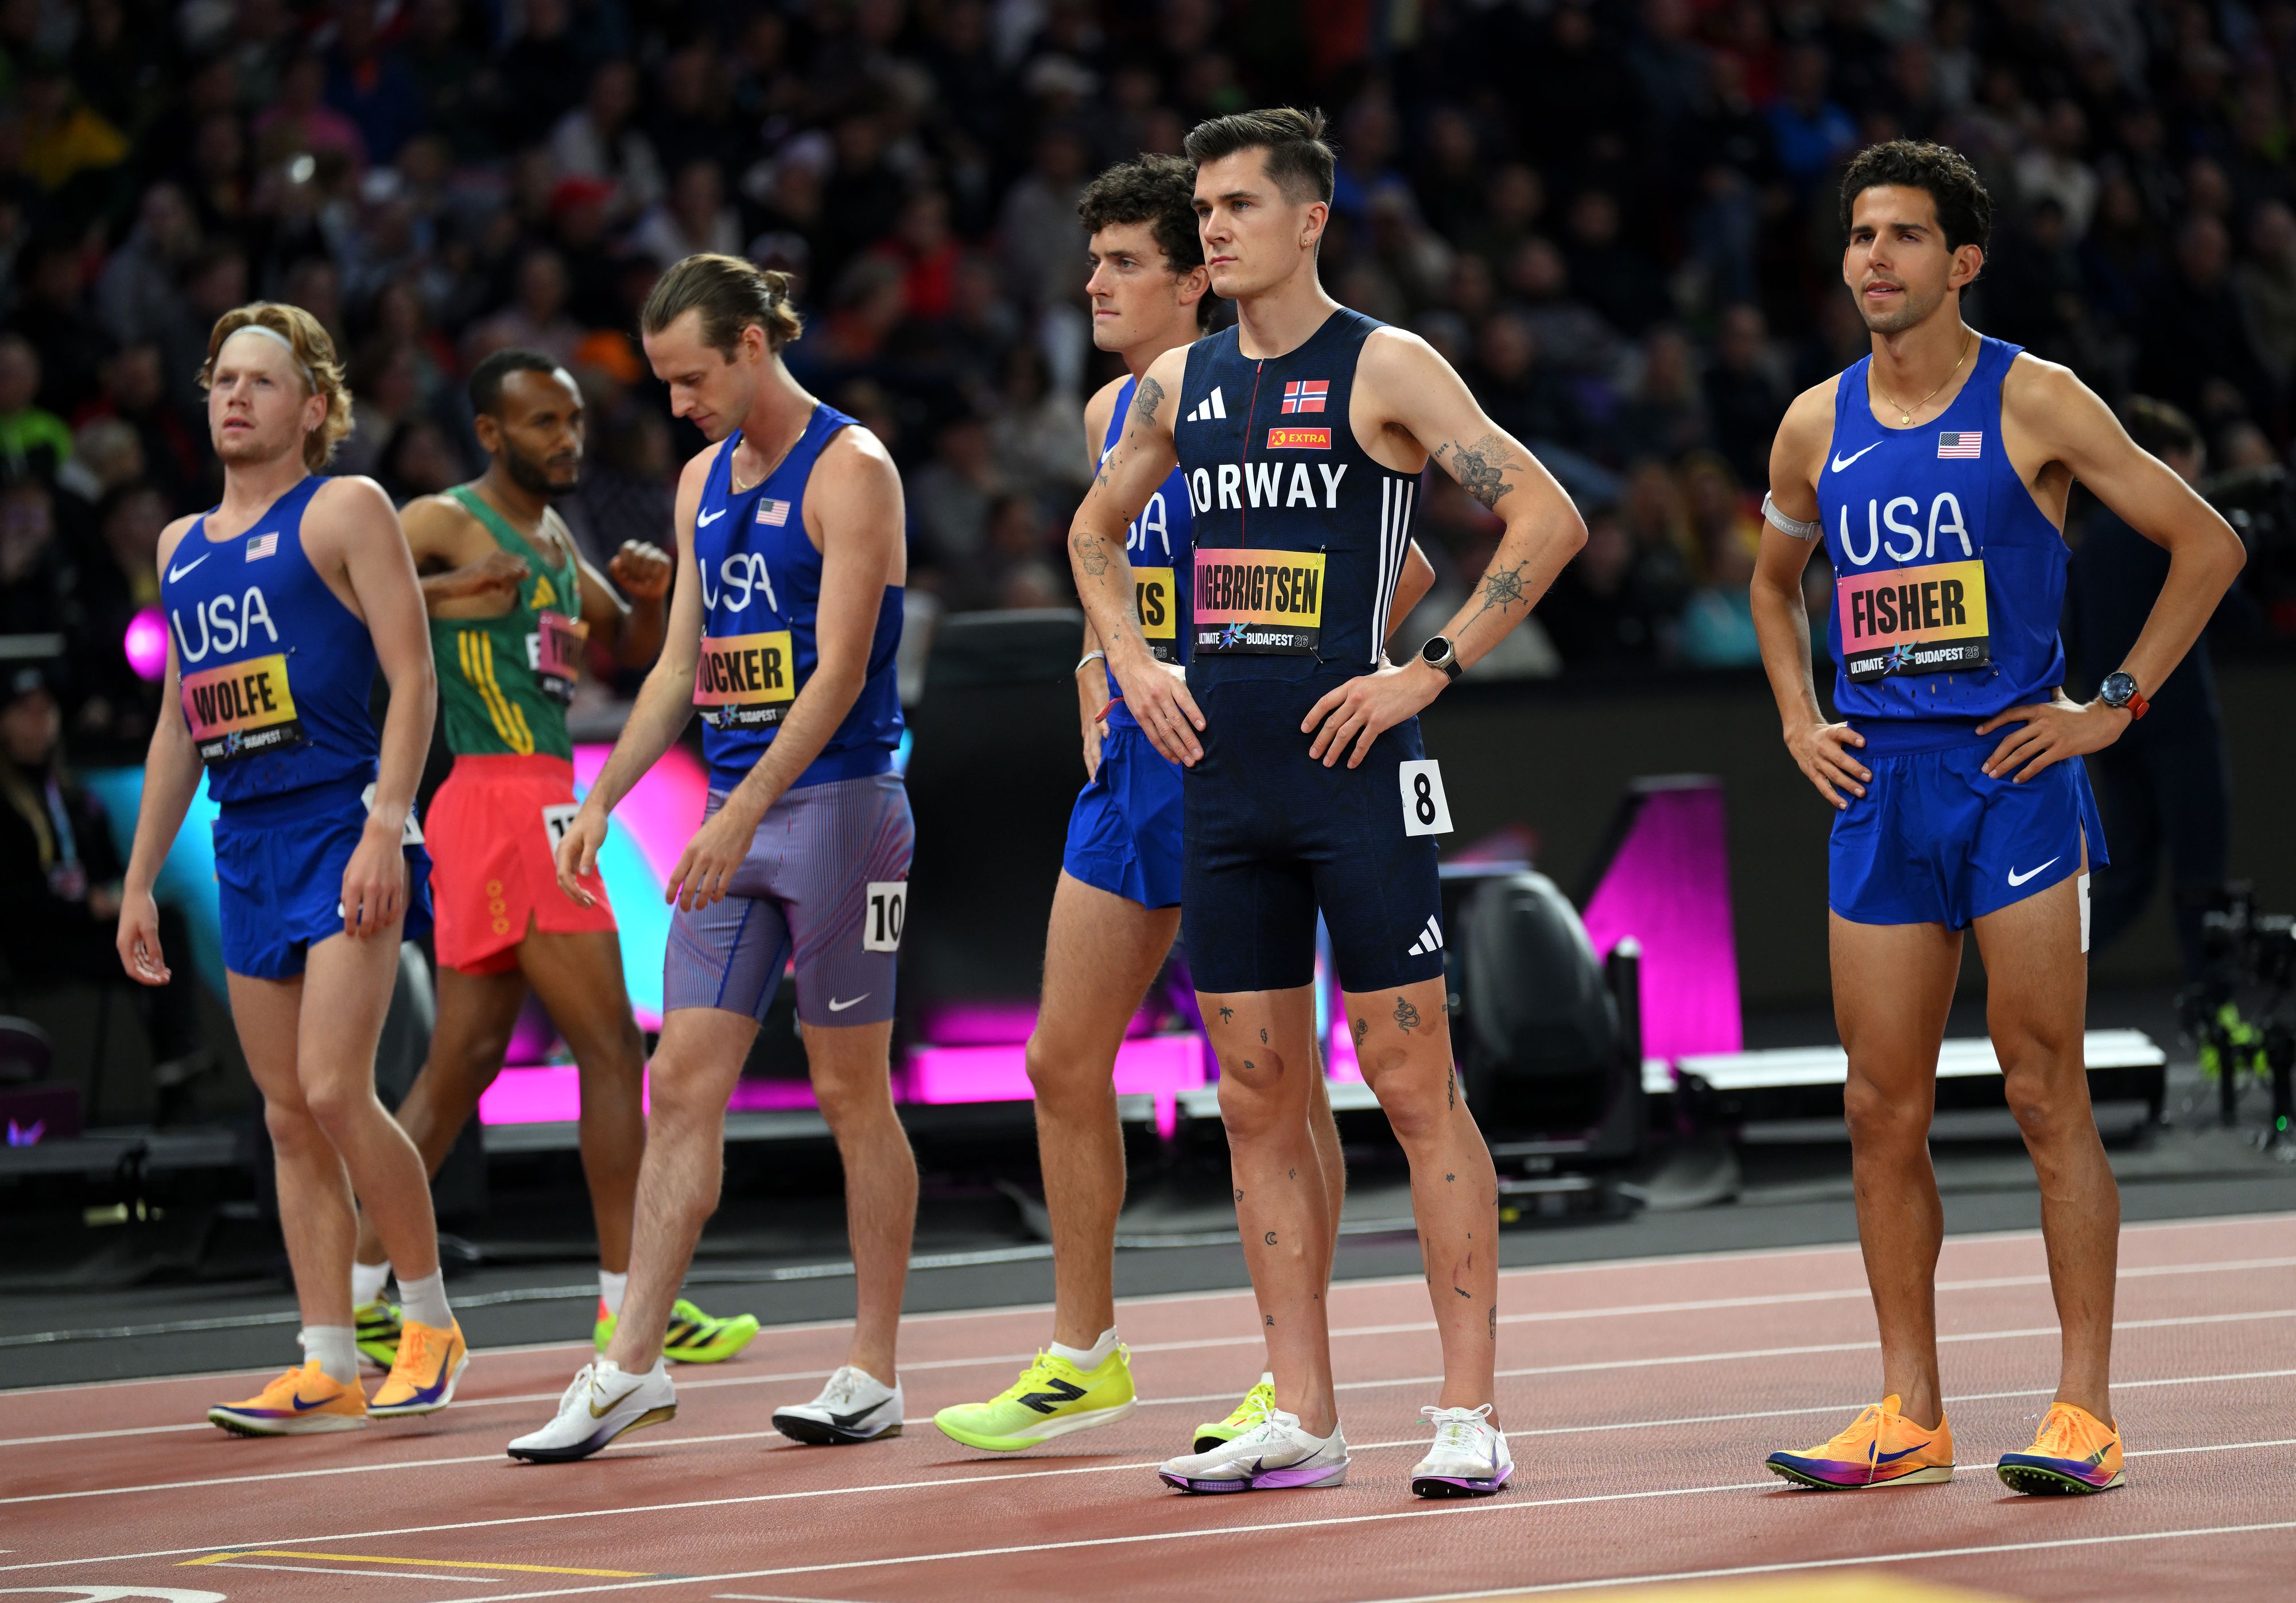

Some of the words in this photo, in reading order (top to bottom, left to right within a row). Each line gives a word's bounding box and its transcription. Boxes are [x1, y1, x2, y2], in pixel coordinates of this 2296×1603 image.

[1289, 434, 1326, 443] EXTRA
[1774, 516, 1808, 534] amazfi
[1840, 492, 1973, 566] USA
[700, 552, 778, 613] USA
[1197, 564, 1319, 614] INGEBRIGTSEN
[172, 585, 279, 663] USA
[1851, 579, 1967, 638] FISHER
[1155, 646, 1167, 658] 26
[1199, 632, 1220, 645] ULTIMATE
[1246, 632, 1294, 646] BUDAPEST
[1294, 635, 1308, 647] 26
[1851, 657, 1884, 674] ULTIMATE
[1915, 647, 1965, 665] BUDAPEST
[1965, 646, 1980, 659] 26
[192, 670, 277, 727] WOLFE
[738, 708, 777, 723] BUDAPEST
[243, 728, 282, 750] BUDAPEST
[1414, 773, 1436, 825] 8
[871, 894, 902, 942] 10
